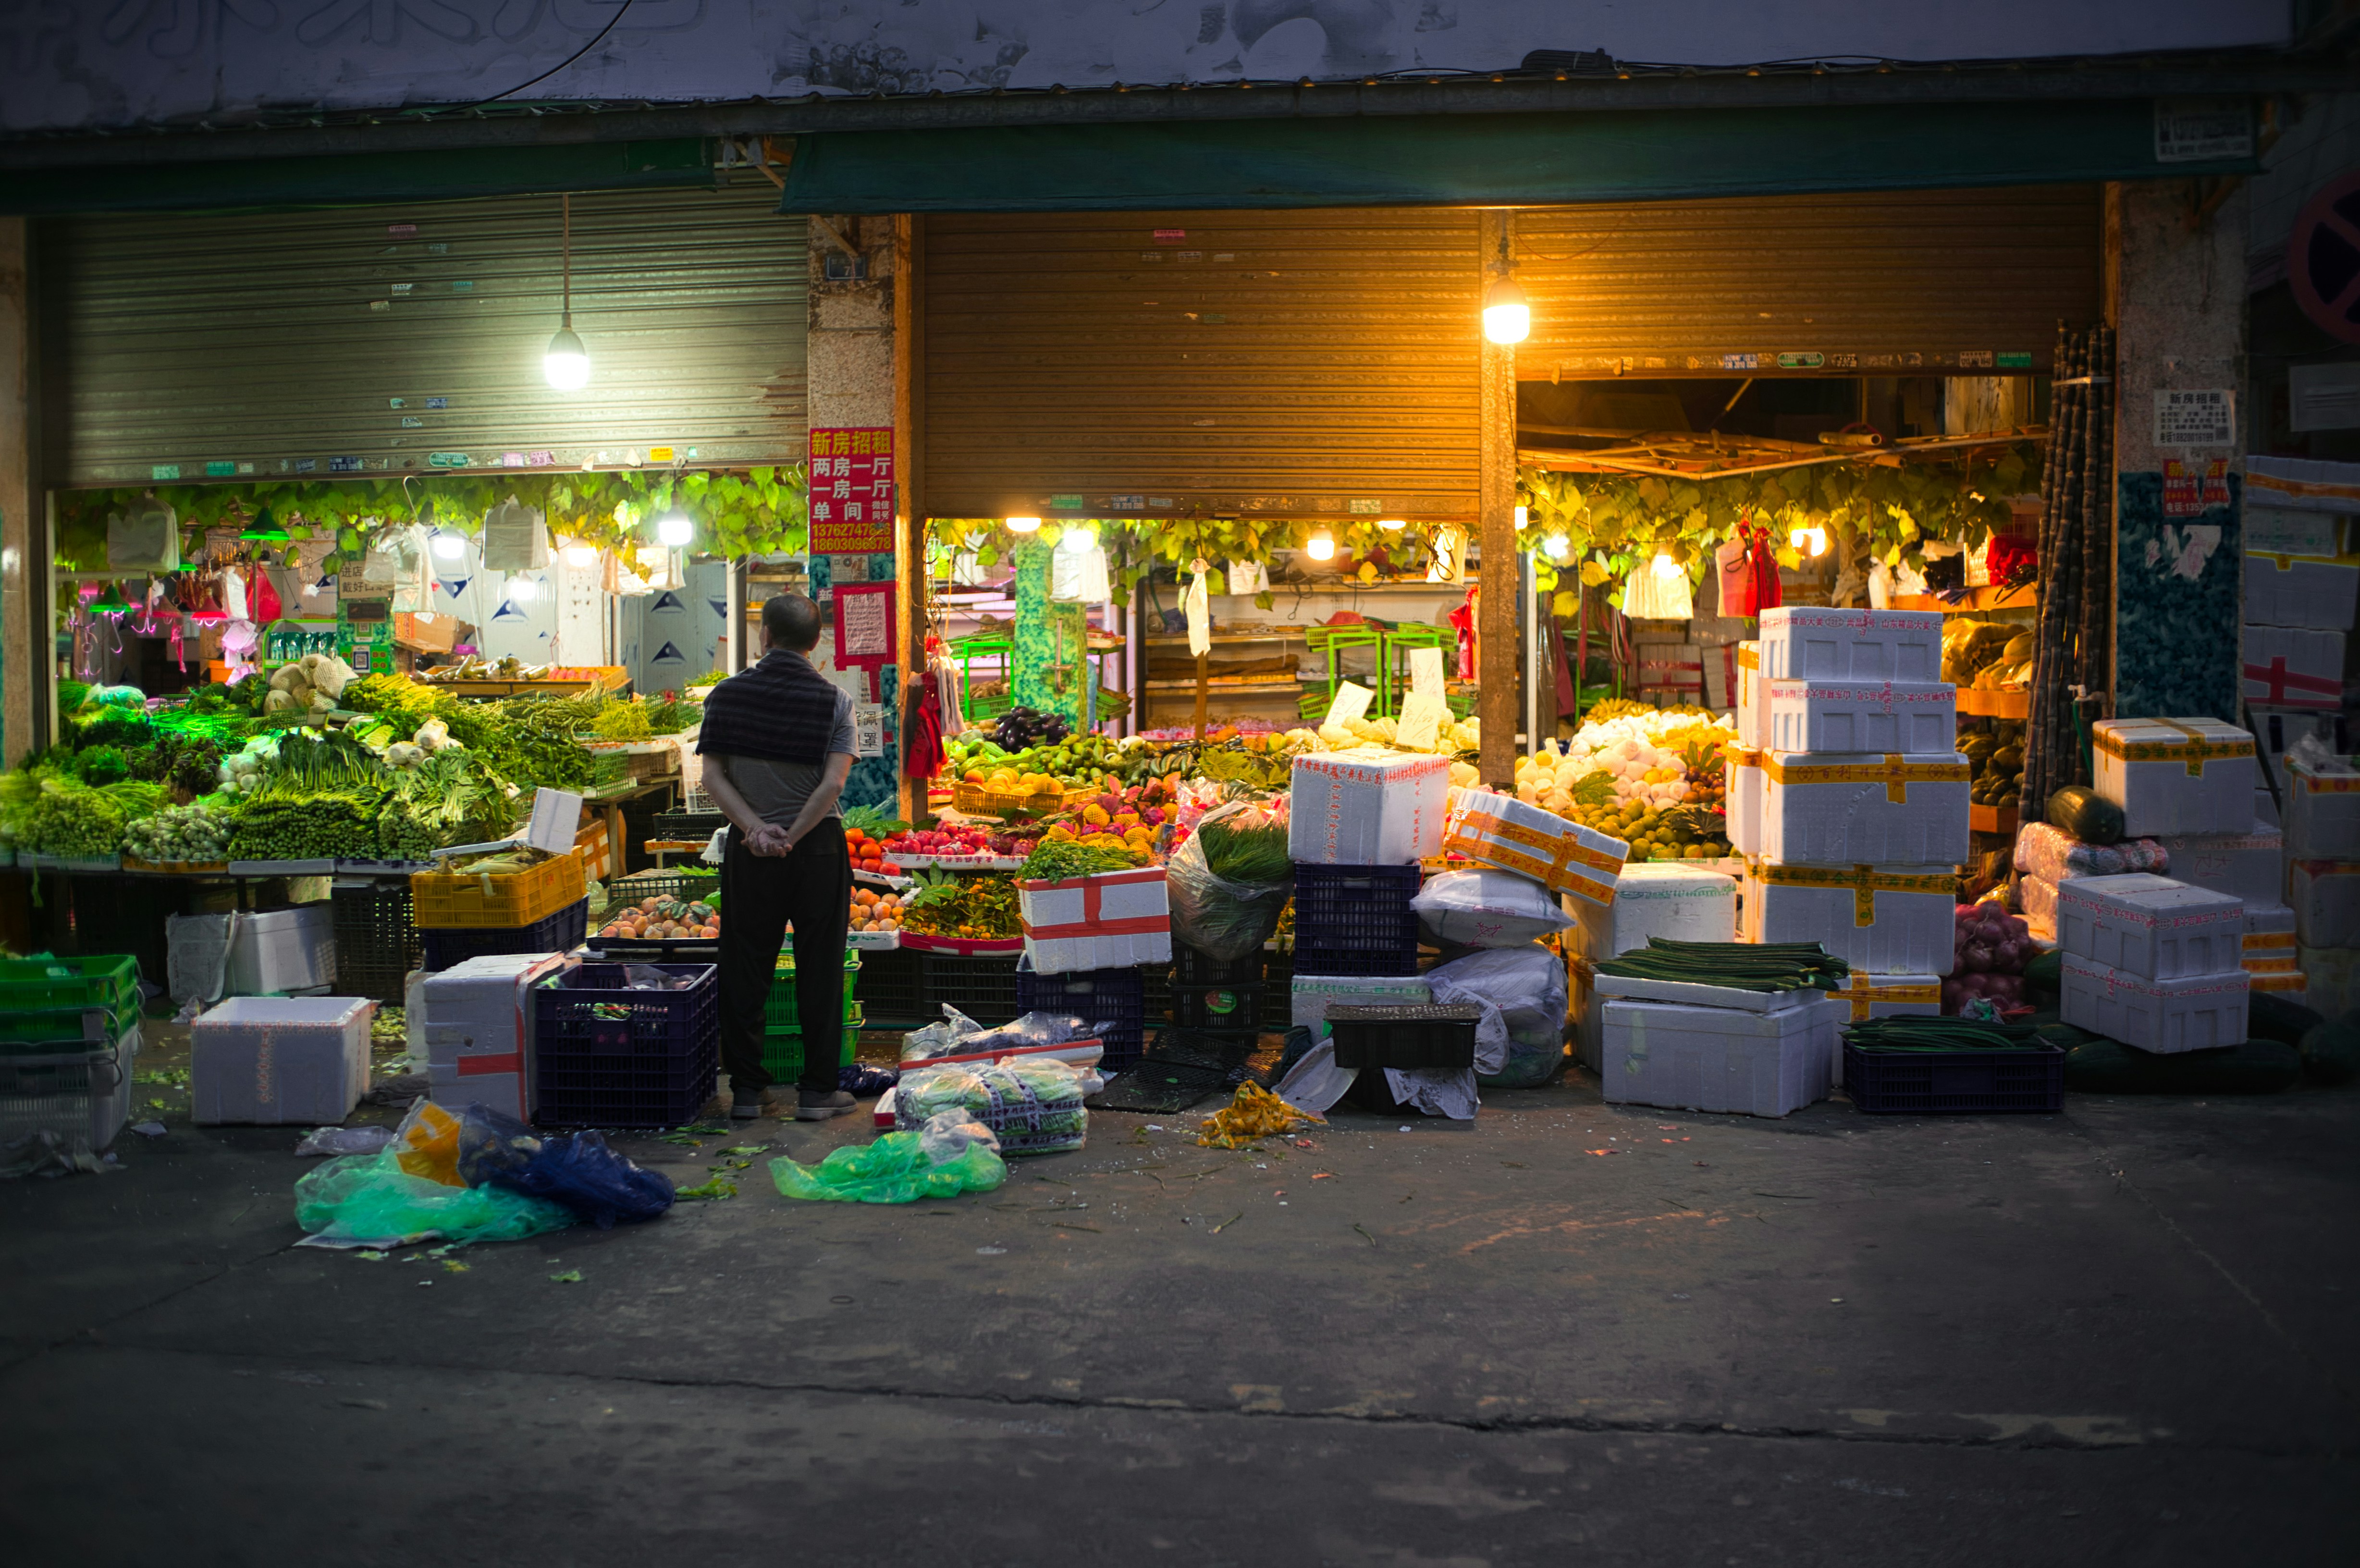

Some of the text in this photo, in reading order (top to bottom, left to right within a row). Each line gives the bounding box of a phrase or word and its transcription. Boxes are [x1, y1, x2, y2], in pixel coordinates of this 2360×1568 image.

[844, 266, 850, 276] 7
[2170, 393, 2221, 404] 新房招租
[812, 431, 892, 455] 新房招租
[812, 457, 891, 477] 两房一厅
[812, 479, 891, 499] 一房一厅
[872, 501, 890, 510] 微信
[872, 511, 890, 520] 同号
[342, 566, 362, 577] 进店
[1881, 619, 1931, 630] 山东精品大姜
[2173, 908, 2243, 927] 山东精品大姜 品1号
